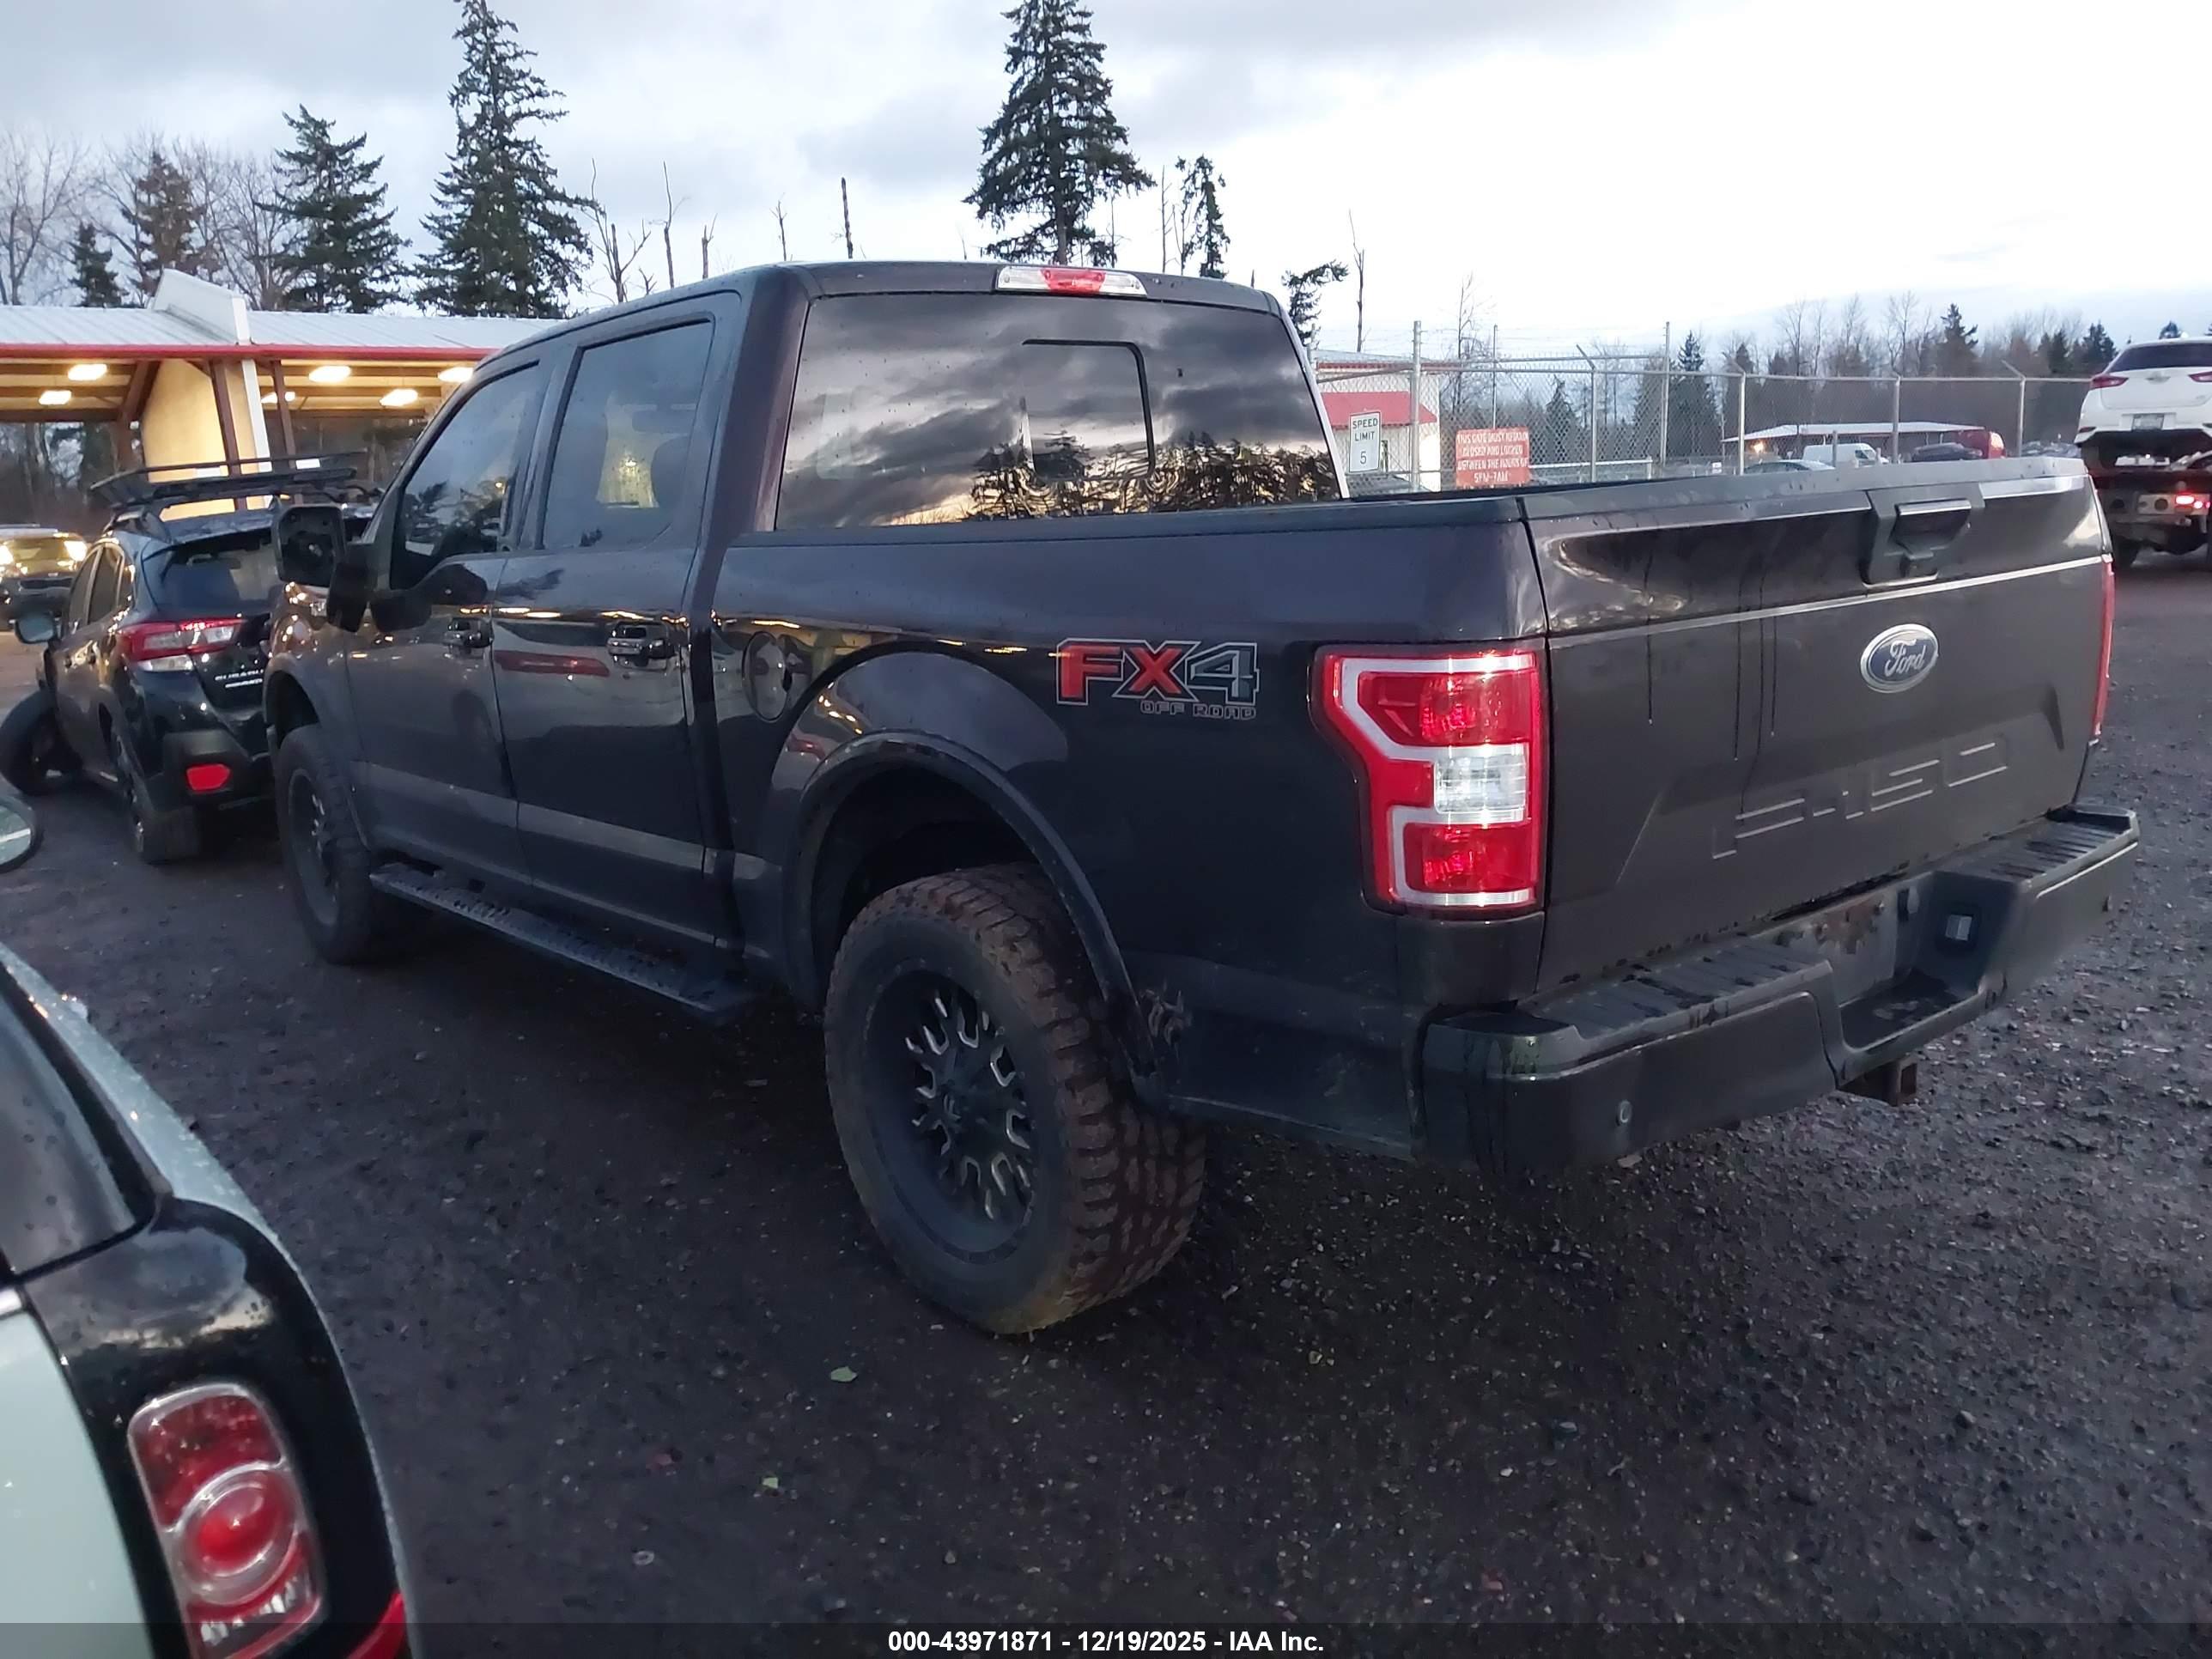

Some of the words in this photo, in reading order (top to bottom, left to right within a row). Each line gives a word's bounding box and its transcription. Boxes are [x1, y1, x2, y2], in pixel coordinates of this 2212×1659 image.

[1352, 417, 1378, 429] SPEED
[1355, 431, 1375, 441] LIMIT
[1359, 451, 1367, 465] 5
[1462, 446, 1486, 457] CLOSED
[1486, 446, 1500, 456] AND
[1457, 459, 1486, 471] BETWEEN
[1487, 459, 1499, 469] THE
[1885, 639, 1927, 677] Ford
[1057, 638, 1260, 706] FX4
[1140, 700, 1185, 715] OFF
[1193, 703, 1256, 720] ROAD
